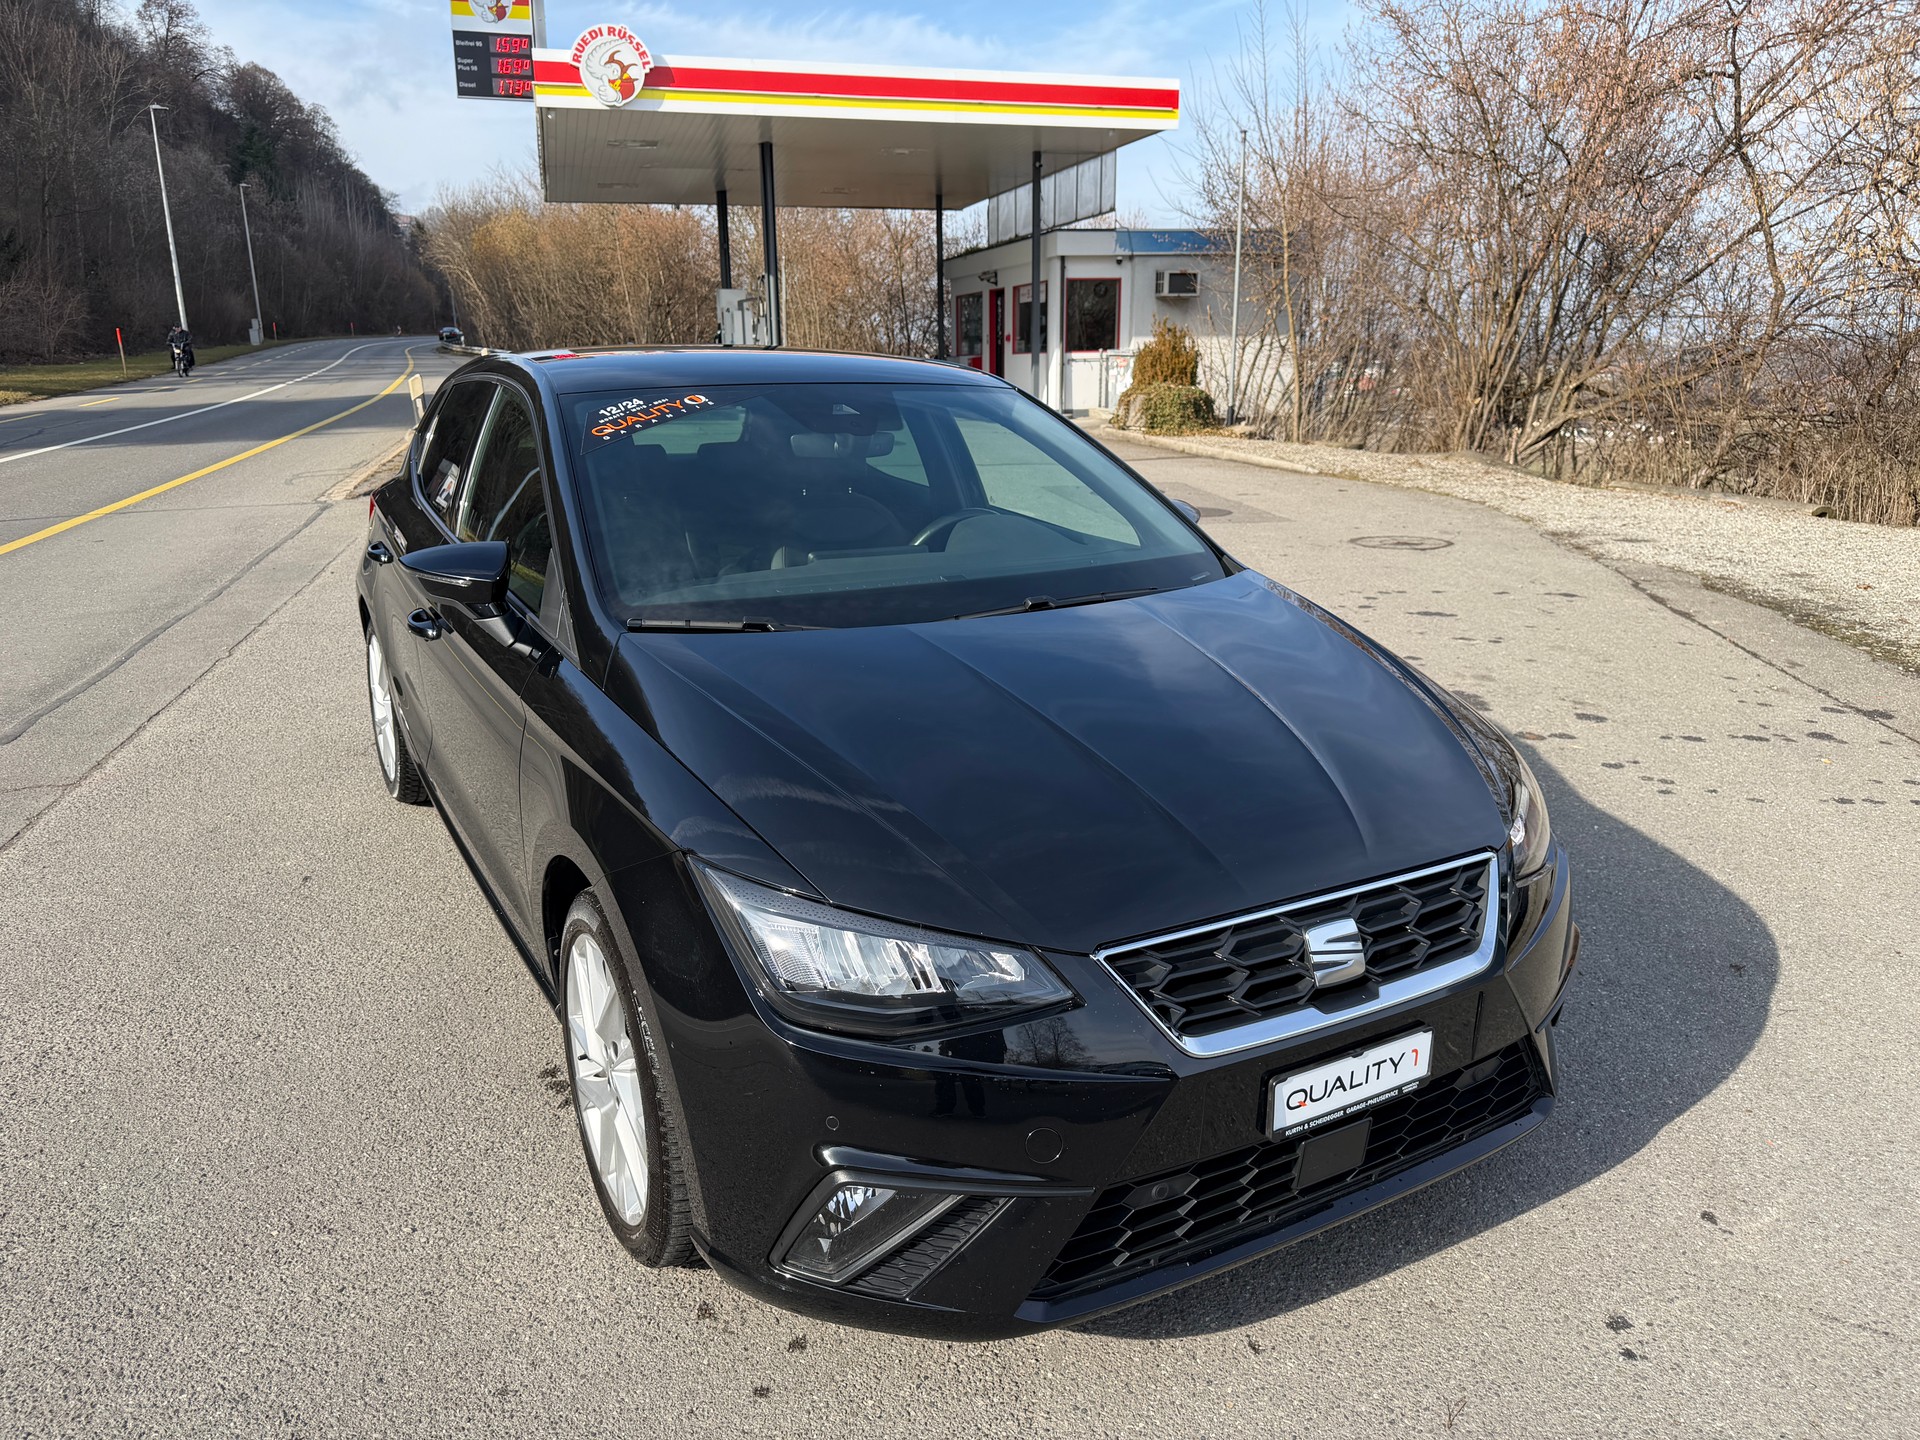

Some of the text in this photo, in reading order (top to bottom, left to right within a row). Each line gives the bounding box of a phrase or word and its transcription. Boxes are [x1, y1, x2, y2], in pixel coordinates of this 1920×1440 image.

[572, 26, 652, 72] RUEDI RÜSSEL
[592, 400, 684, 436] QUALITY
[598, 398, 644, 416] 12/24
[1286, 1048, 1419, 1110] QUALITY 1
[1285, 1124, 1303, 1136] KURTH
[1309, 1111, 1345, 1128] SCHEIDEGGER
[1346, 1089, 1399, 1114] GARAGE-PNEUSERVICE
